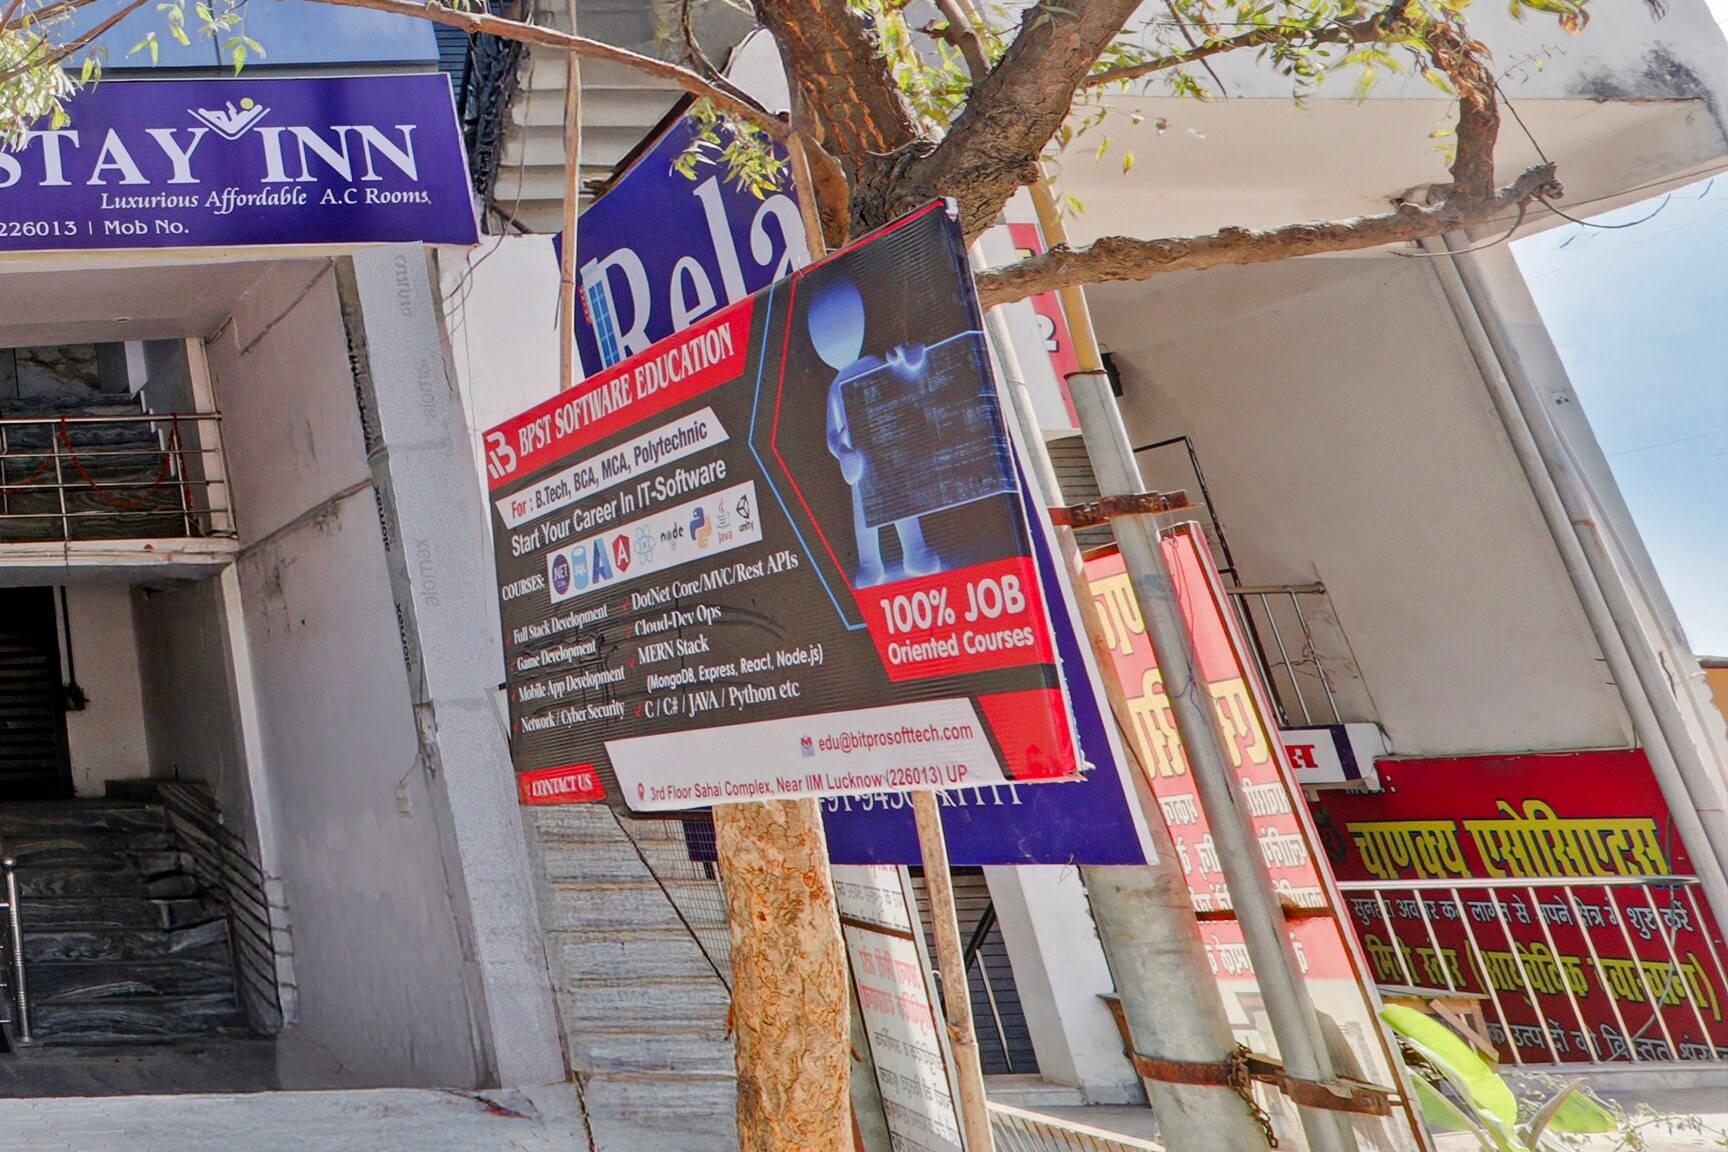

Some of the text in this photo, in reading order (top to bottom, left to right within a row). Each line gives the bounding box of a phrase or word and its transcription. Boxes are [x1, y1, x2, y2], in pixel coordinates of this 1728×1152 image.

[253, 124, 419, 184] INN
[100, 191, 199, 210] Luxurious
[204, 186, 308, 215] Affordable
[319, 188, 358, 205] A.C
[104, 219, 148, 236] Mob
[154, 218, 190, 235] No.
[597, 175, 813, 361] Rela
[518, 414, 553, 458] BPST
[555, 372, 633, 440] SOFTWARE
[634, 322, 735, 401] EDUCATION
[511, 499, 527, 520] For
[535, 480, 572, 509] B.Tech,
[573, 466, 600, 493] BCA,
[601, 456, 632, 481] MCA,
[633, 421, 708, 467] Polytechnic
[511, 459, 727, 558] Start Your Career In IT-Software
[502, 573, 545, 601] COURSES:
[631, 585, 671, 610] DotNet
[767, 550, 799, 575] APIs
[634, 604, 722, 637] Cloud-Dev Ops
[880, 574, 1026, 635] 100% JOB
[514, 604, 608, 644] Full Stack Development
[517, 639, 597, 671] Game Development
[638, 633, 710, 665] MERN Stack
[887, 626, 1035, 665] Oriented Courses
[519, 665, 625, 702] Mobile App Development
[647, 643, 823, 694] (MongoDB, Express, React, Node.js)
[521, 712, 556, 733] Network
[561, 707, 587, 728] Cyber
[587, 699, 625, 719] Security
[688, 690, 720, 717] JAVA
[728, 681, 777, 711] Python
[779, 681, 801, 699] etc
[818, 724, 974, 753] edu@bitprosofttech.com
[532, 773, 593, 798] CONTACT US
[650, 786, 666, 801] 3rd
[668, 783, 692, 800] Floor
[695, 781, 721, 797] Sahai
[724, 778, 775, 797] Complex,
[776, 776, 803, 794] Near
[806, 773, 823, 791] IIM
[826, 770, 883, 789] Lucknow
[947, 764, 968, 783] UP
